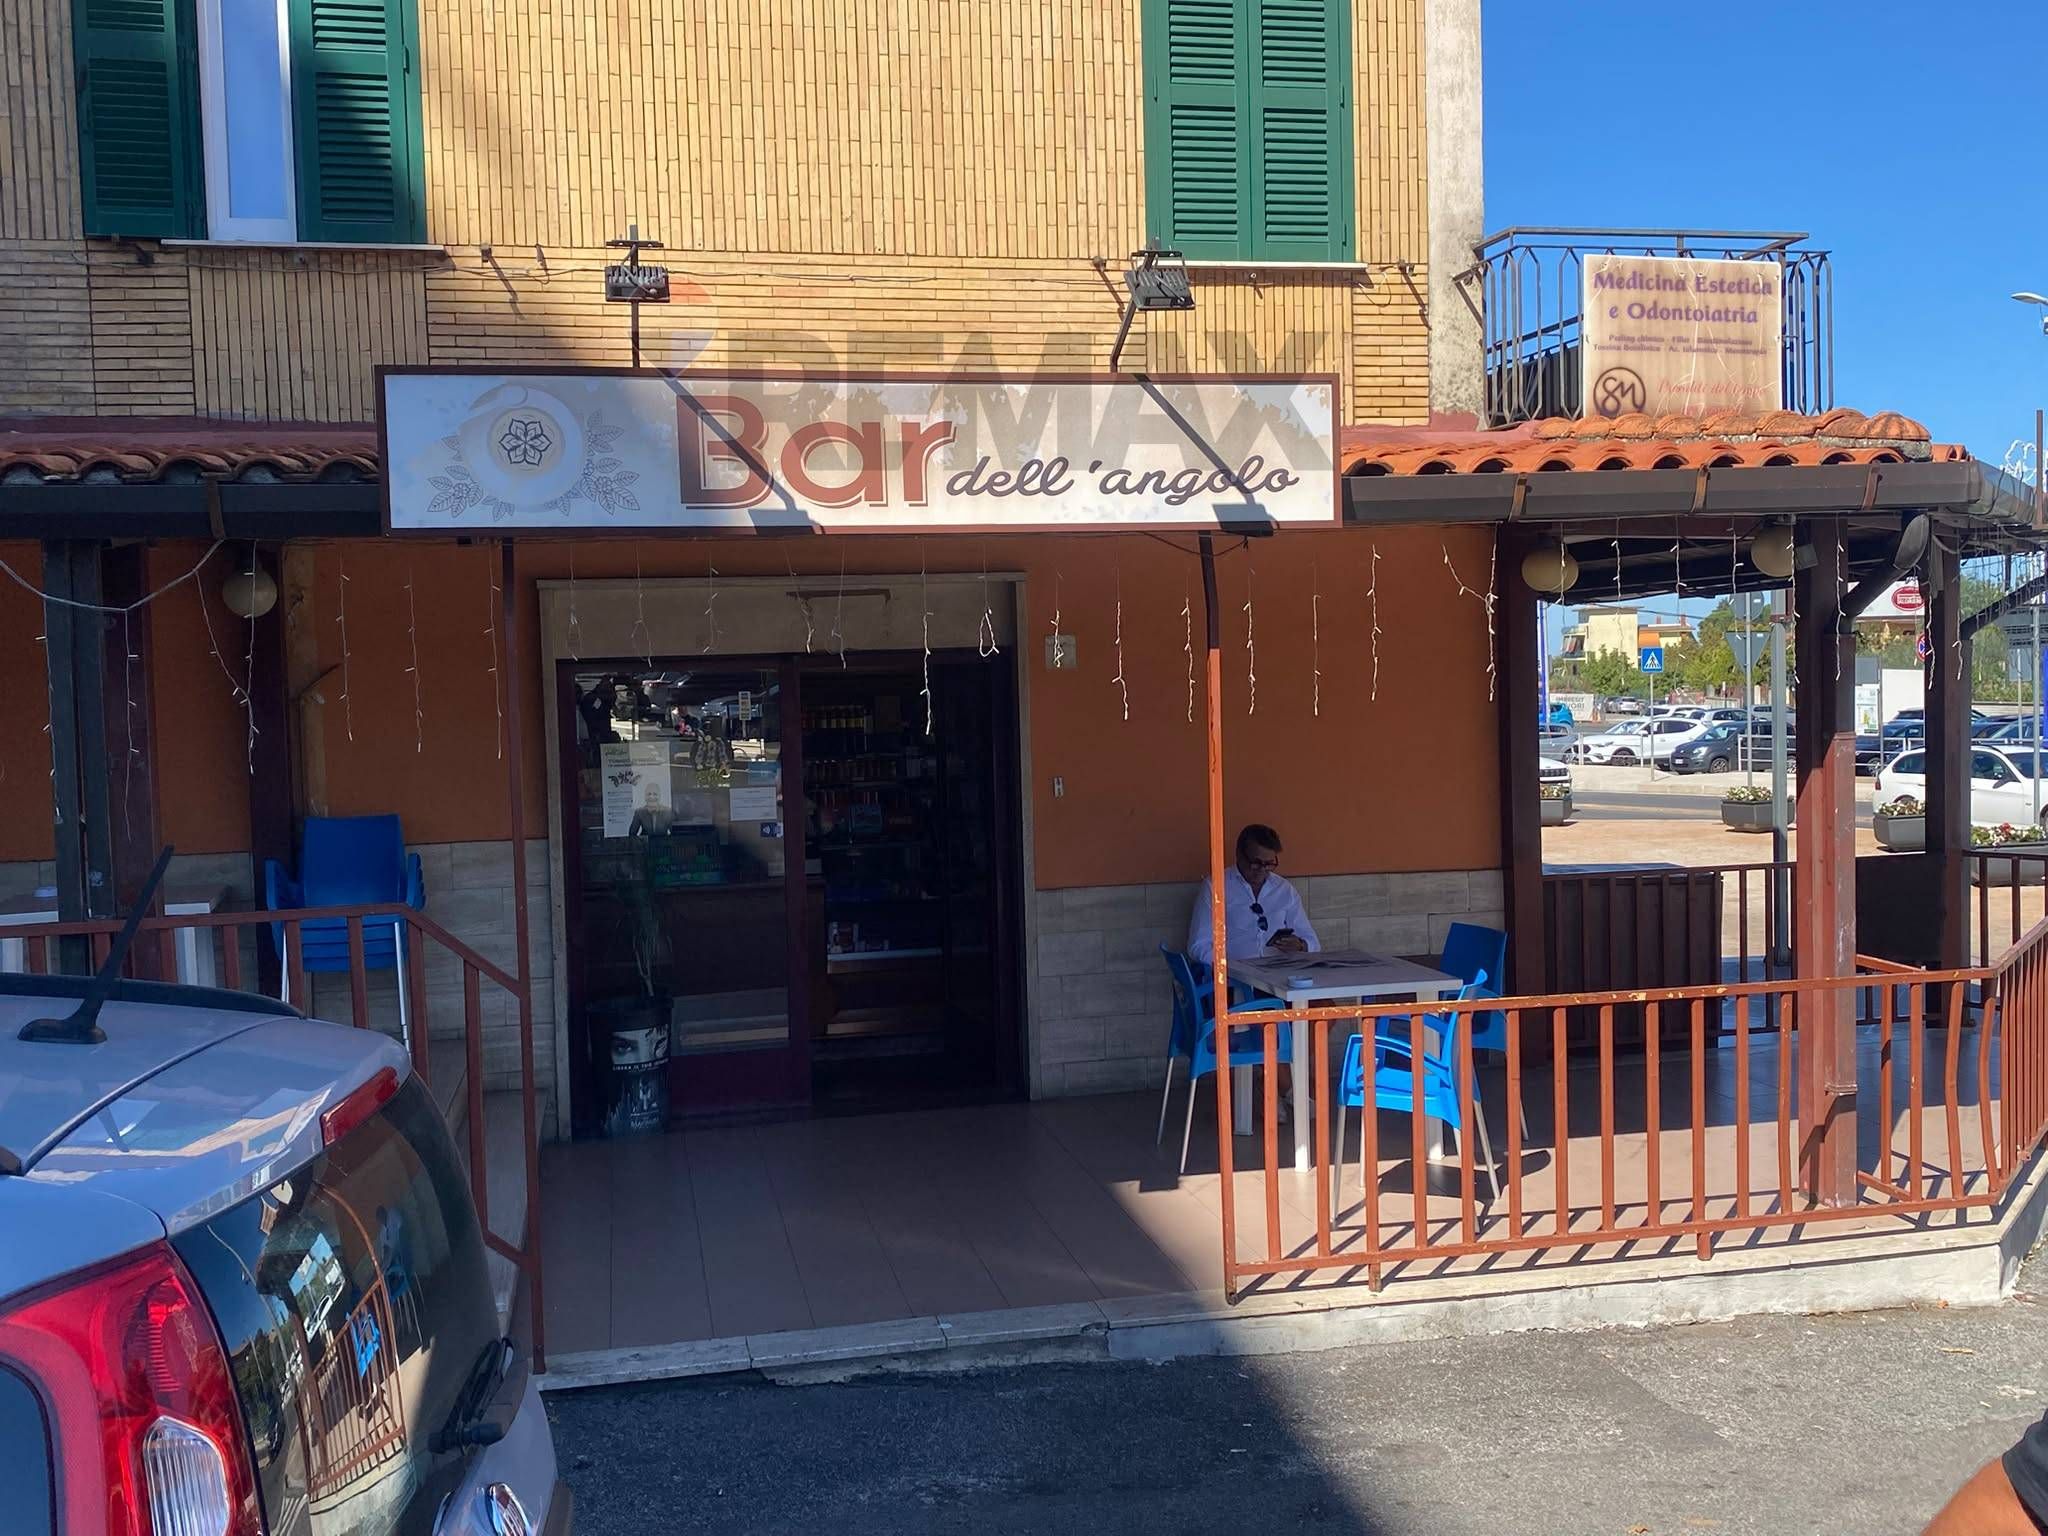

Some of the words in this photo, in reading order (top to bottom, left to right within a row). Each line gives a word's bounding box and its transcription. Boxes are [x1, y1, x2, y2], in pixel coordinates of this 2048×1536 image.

[1593, 272, 1687, 292] Medicina
[1695, 276, 1773, 296] Estetica
[1608, 305, 1619, 319] e
[1627, 302, 1758, 324] Odontoiatria
[676, 394, 957, 510] Bar
